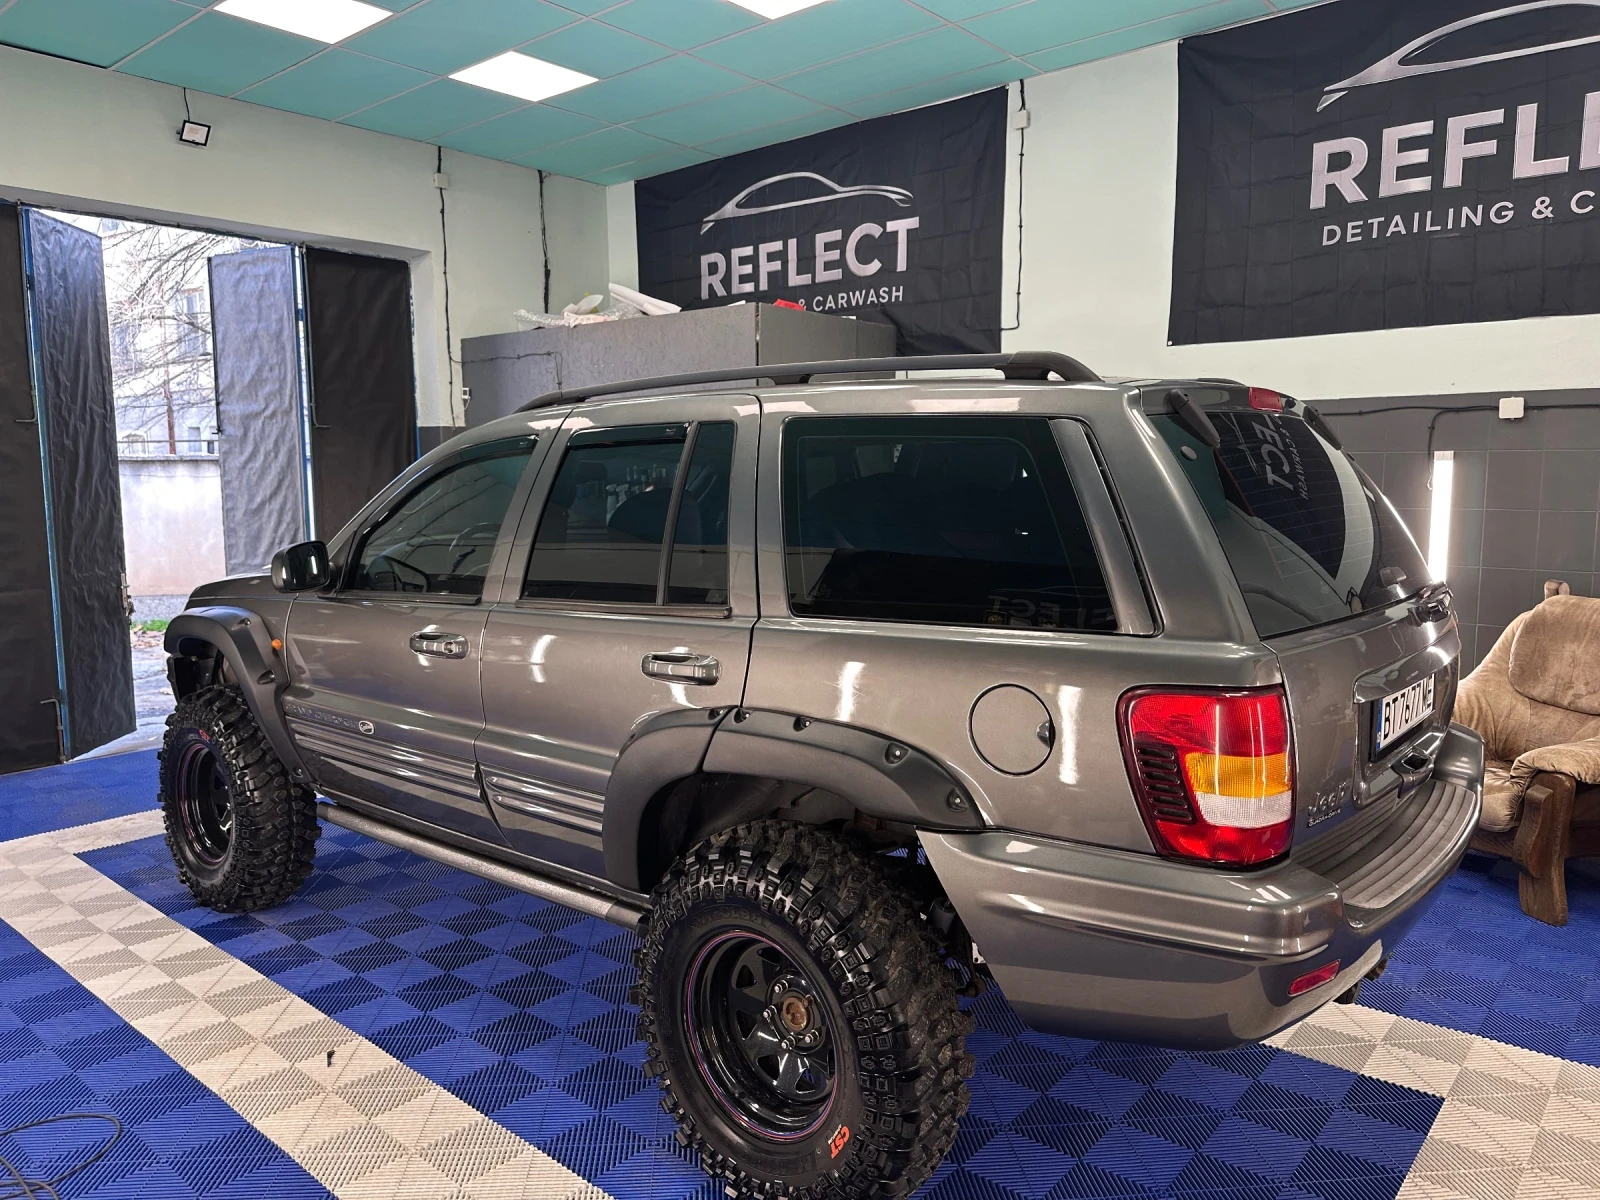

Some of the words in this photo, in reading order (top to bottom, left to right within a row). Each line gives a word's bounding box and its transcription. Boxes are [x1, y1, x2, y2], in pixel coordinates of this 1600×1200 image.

[1322, 201, 1514, 247] DETAILING
[1531, 196, 1555, 220] &
[700, 216, 920, 300] REFLECT
[812, 286, 904, 312] CARWASH
[830, 1125, 850, 1160] CST
